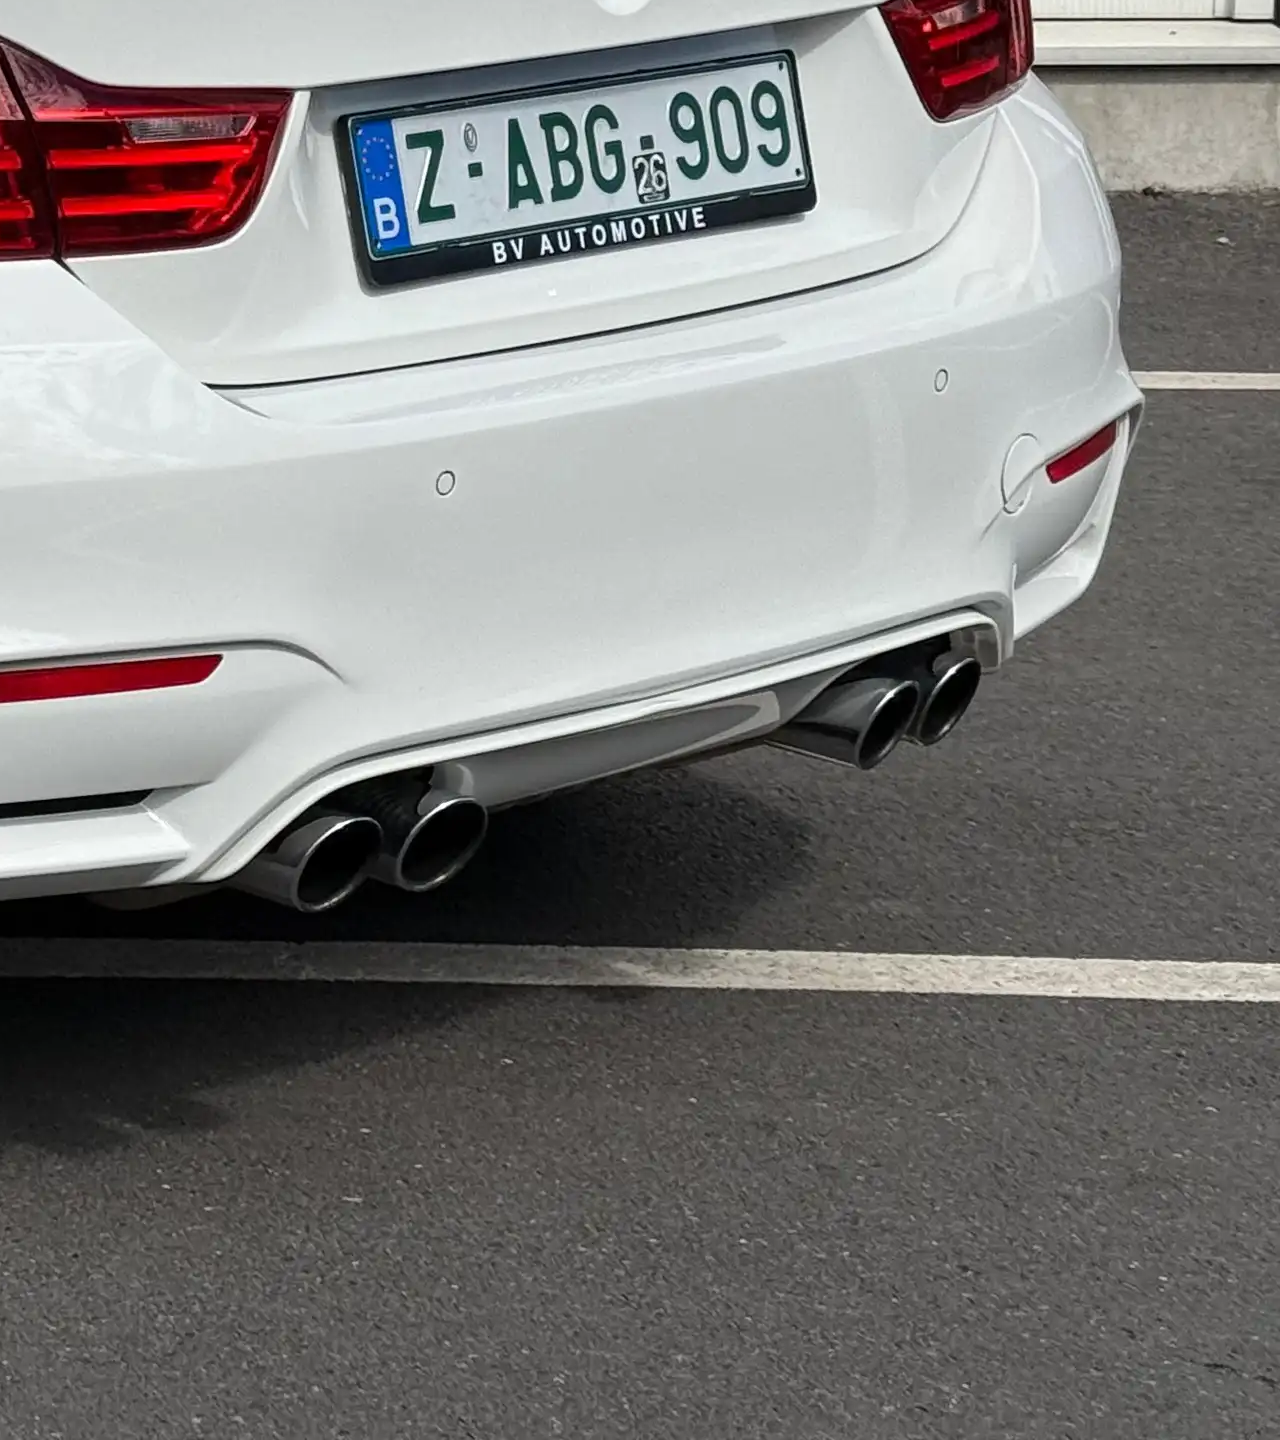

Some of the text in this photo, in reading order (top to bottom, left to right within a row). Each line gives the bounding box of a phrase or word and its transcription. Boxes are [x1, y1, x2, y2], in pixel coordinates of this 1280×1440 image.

[633, 152, 669, 195] 26
[372, 196, 401, 241] B
[491, 205, 708, 265] BV AUTOMOTIVE
